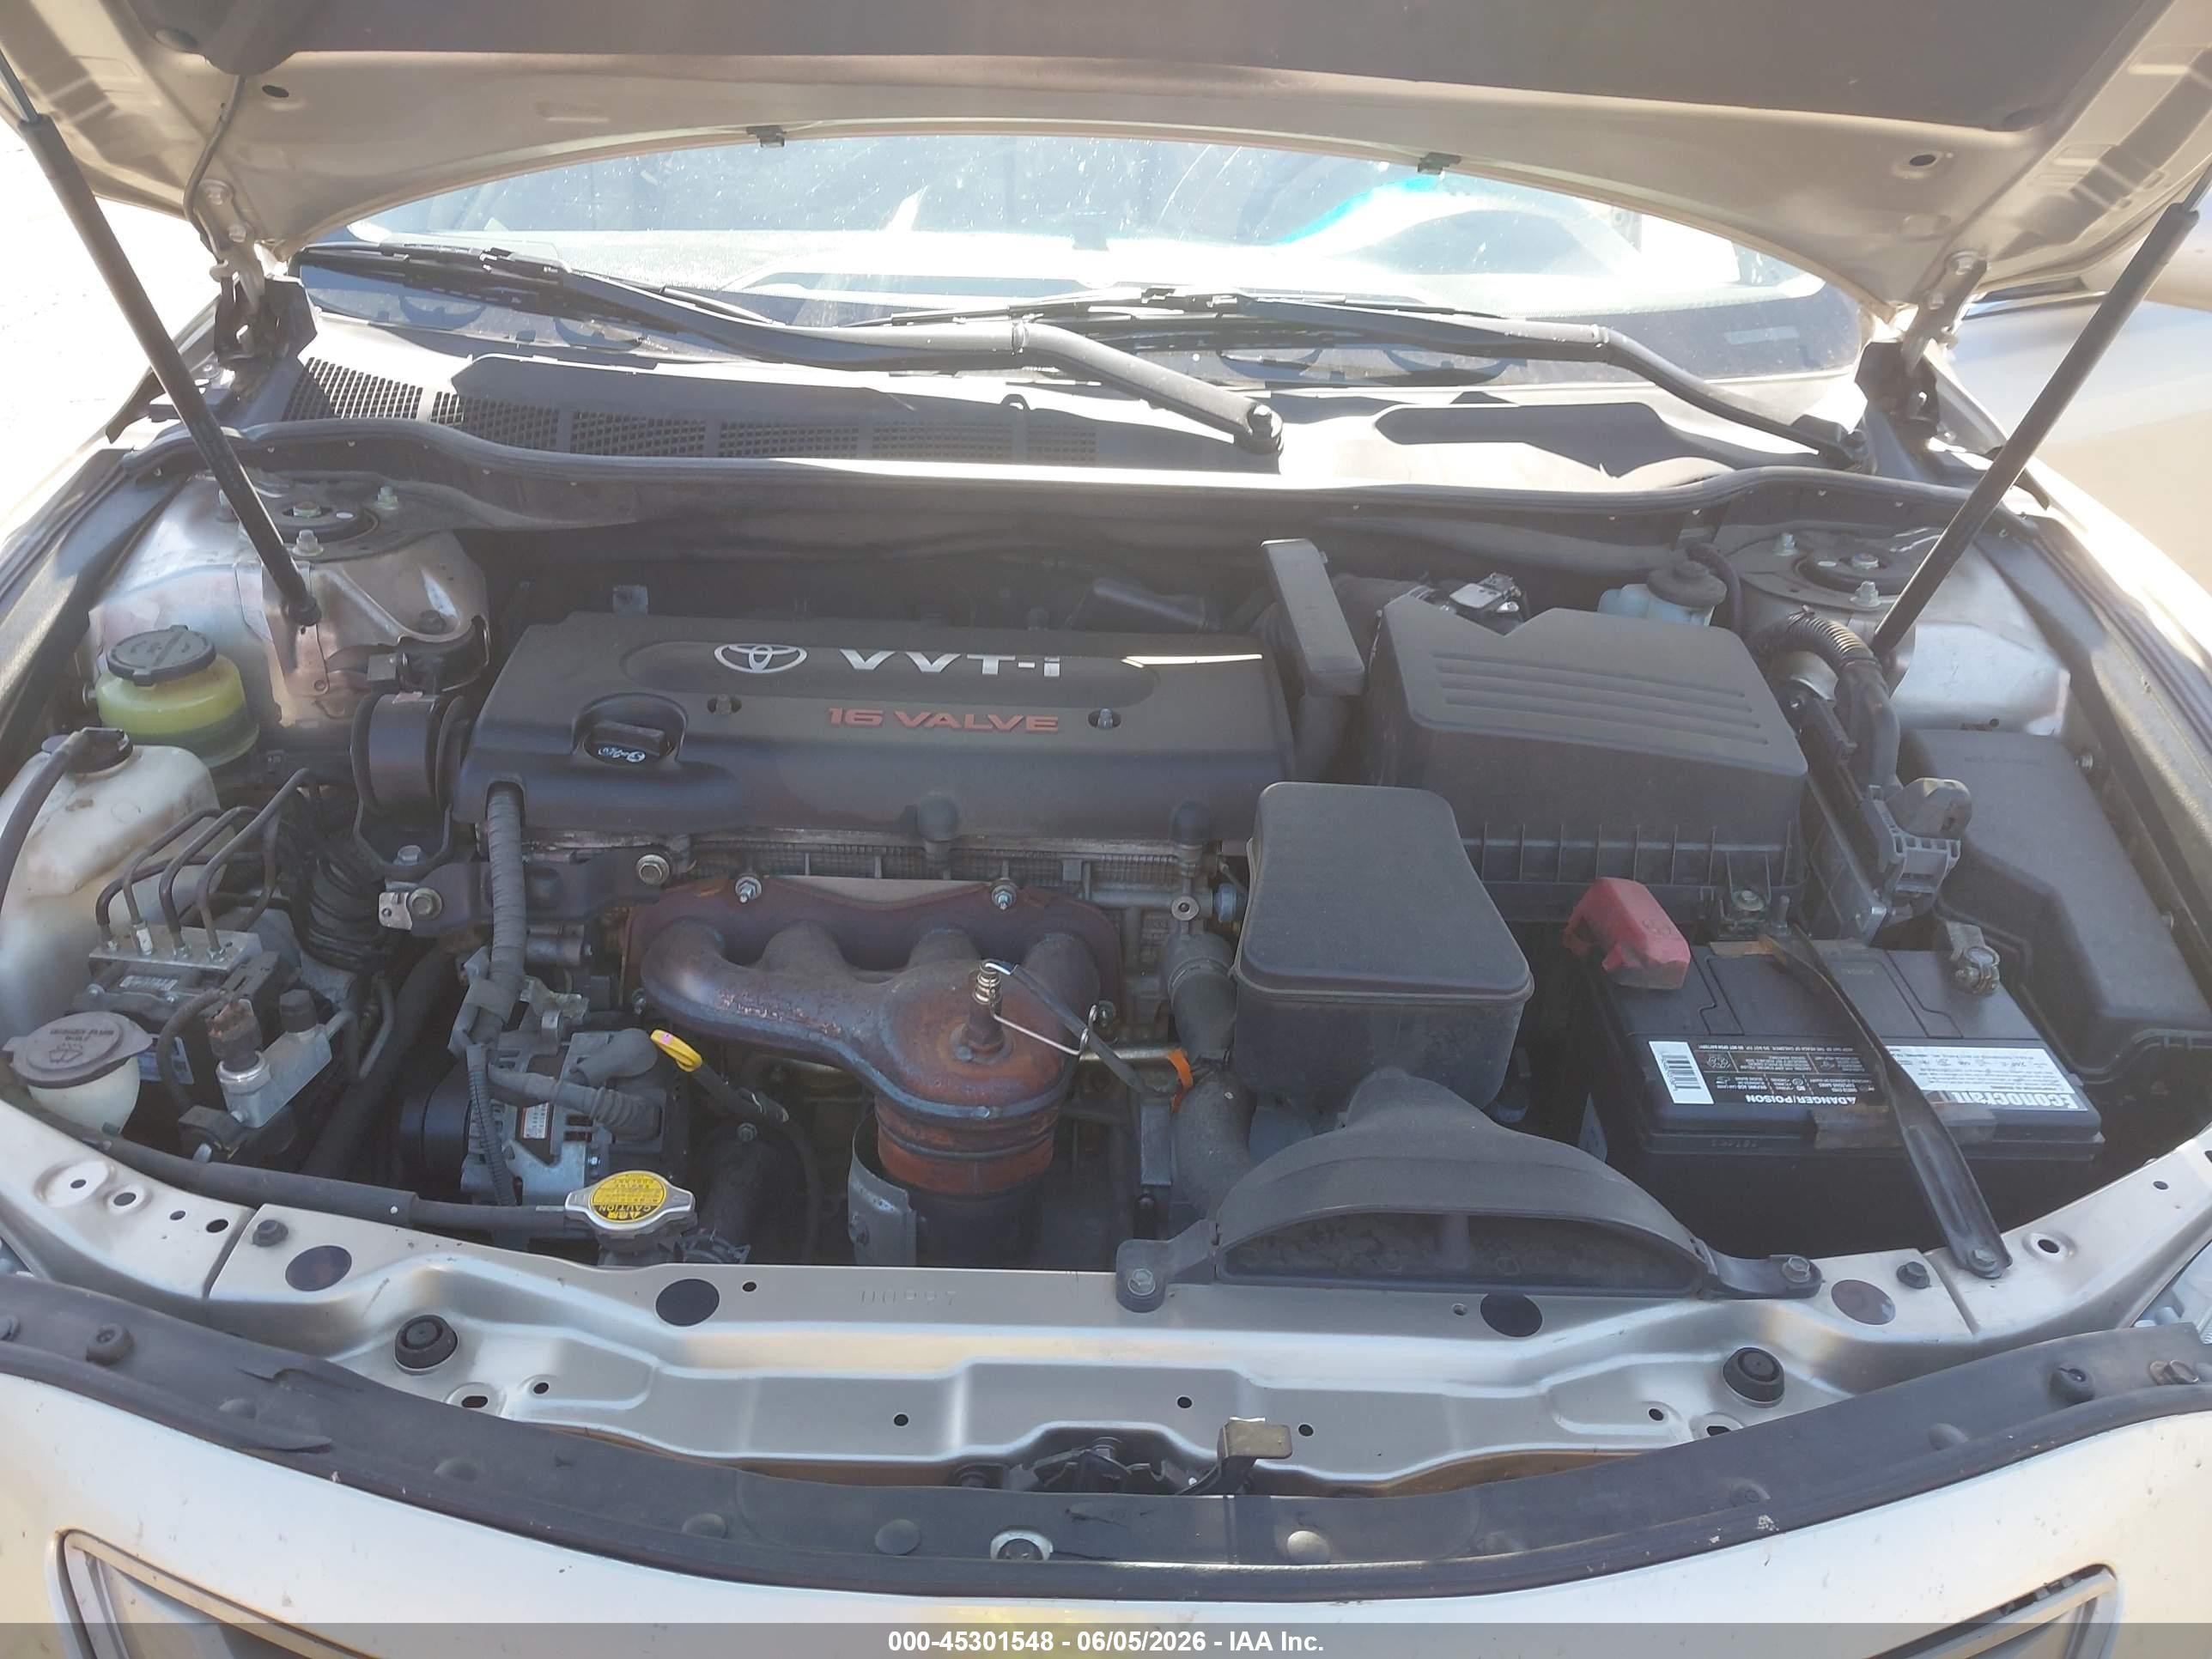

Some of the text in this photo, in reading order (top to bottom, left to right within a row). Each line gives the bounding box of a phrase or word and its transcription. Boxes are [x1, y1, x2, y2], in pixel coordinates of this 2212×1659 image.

[839, 648, 1060, 677] VVT-i
[828, 707, 1059, 733] 16 VALVE
